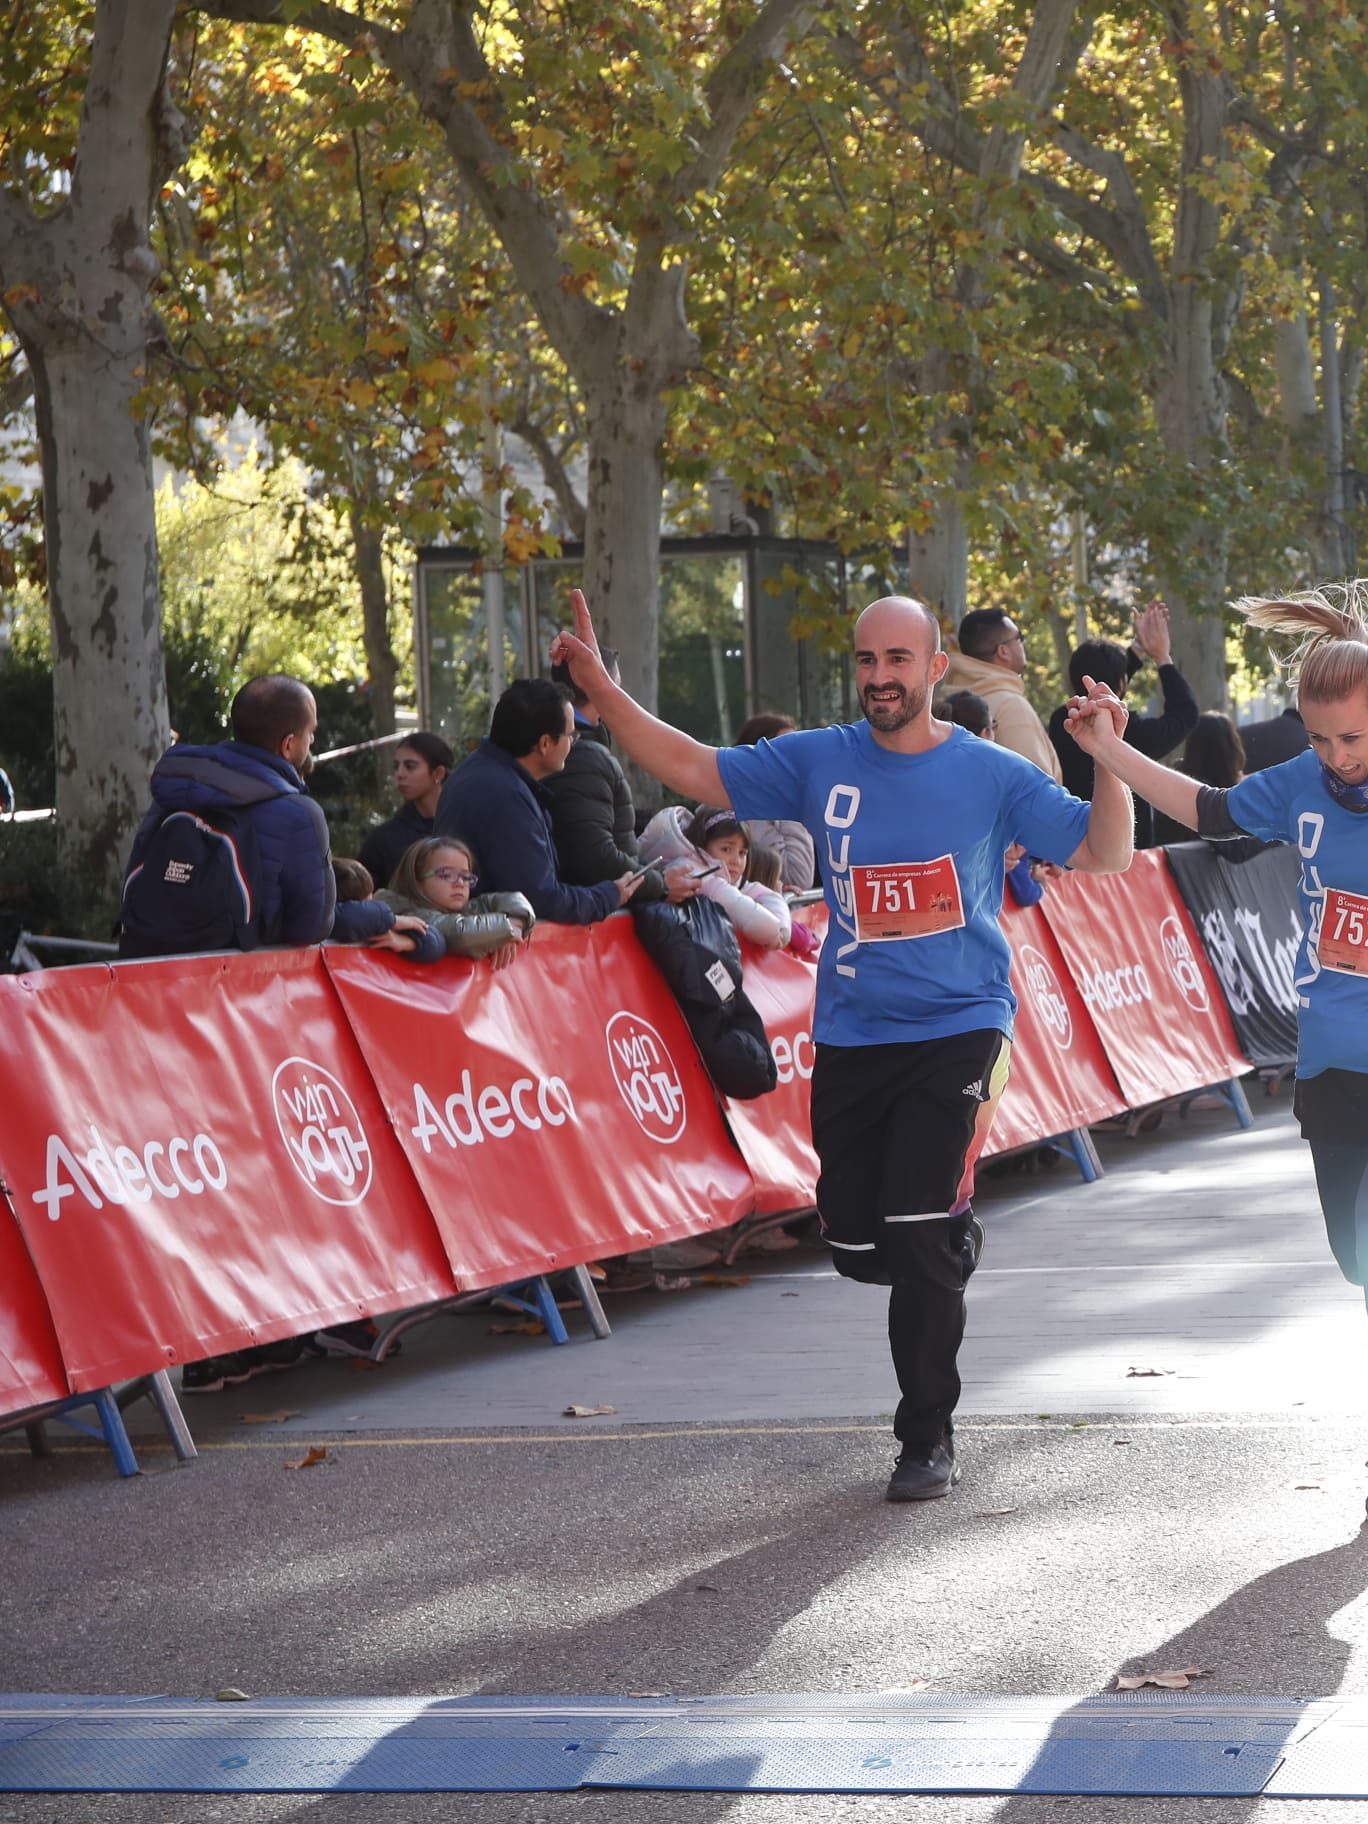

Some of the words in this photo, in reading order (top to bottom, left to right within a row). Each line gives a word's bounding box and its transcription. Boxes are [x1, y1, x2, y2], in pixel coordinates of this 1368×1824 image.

[824, 784, 861, 979] IVECO
[866, 879, 916, 913] 751
[1080, 958, 1152, 1011] Adecco
[32, 1125, 228, 1221] Adecco
